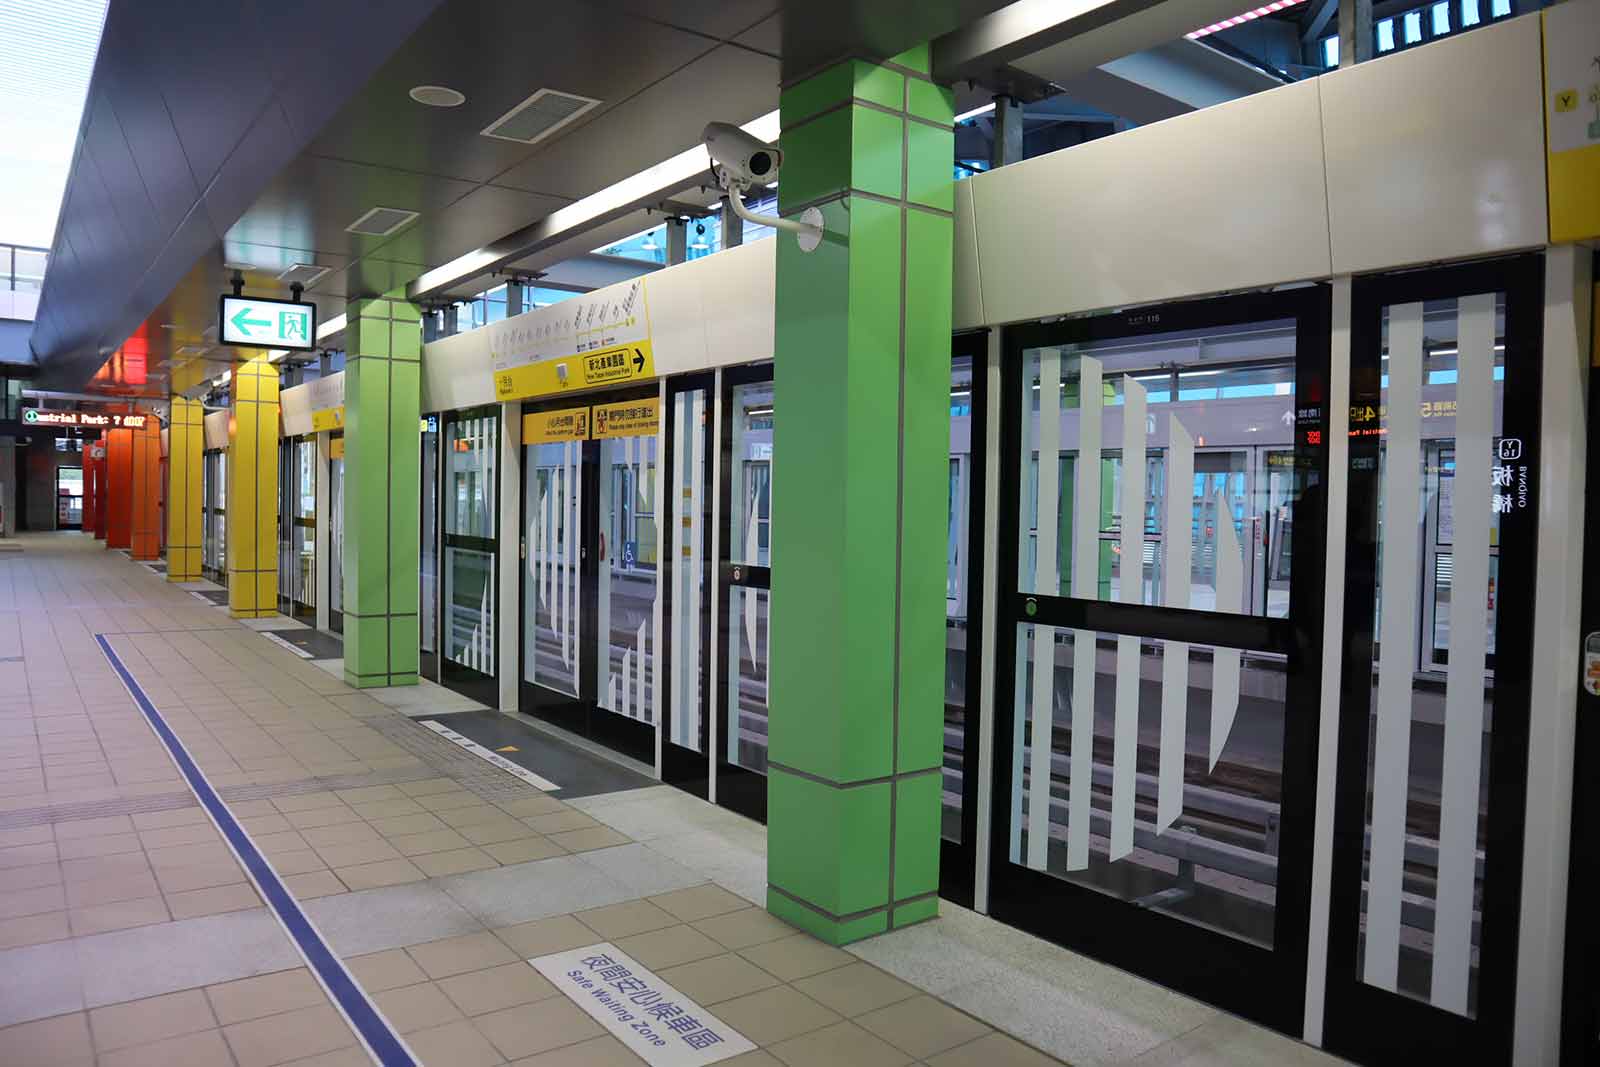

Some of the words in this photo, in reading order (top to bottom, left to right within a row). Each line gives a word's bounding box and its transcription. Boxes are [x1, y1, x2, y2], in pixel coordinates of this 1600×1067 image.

[567, 969, 593, 989] Safe
[591, 988, 635, 1022] Waiting
[631, 1021, 667, 1047] Zone
[580, 953, 725, 1050] 夜間安心候車區
